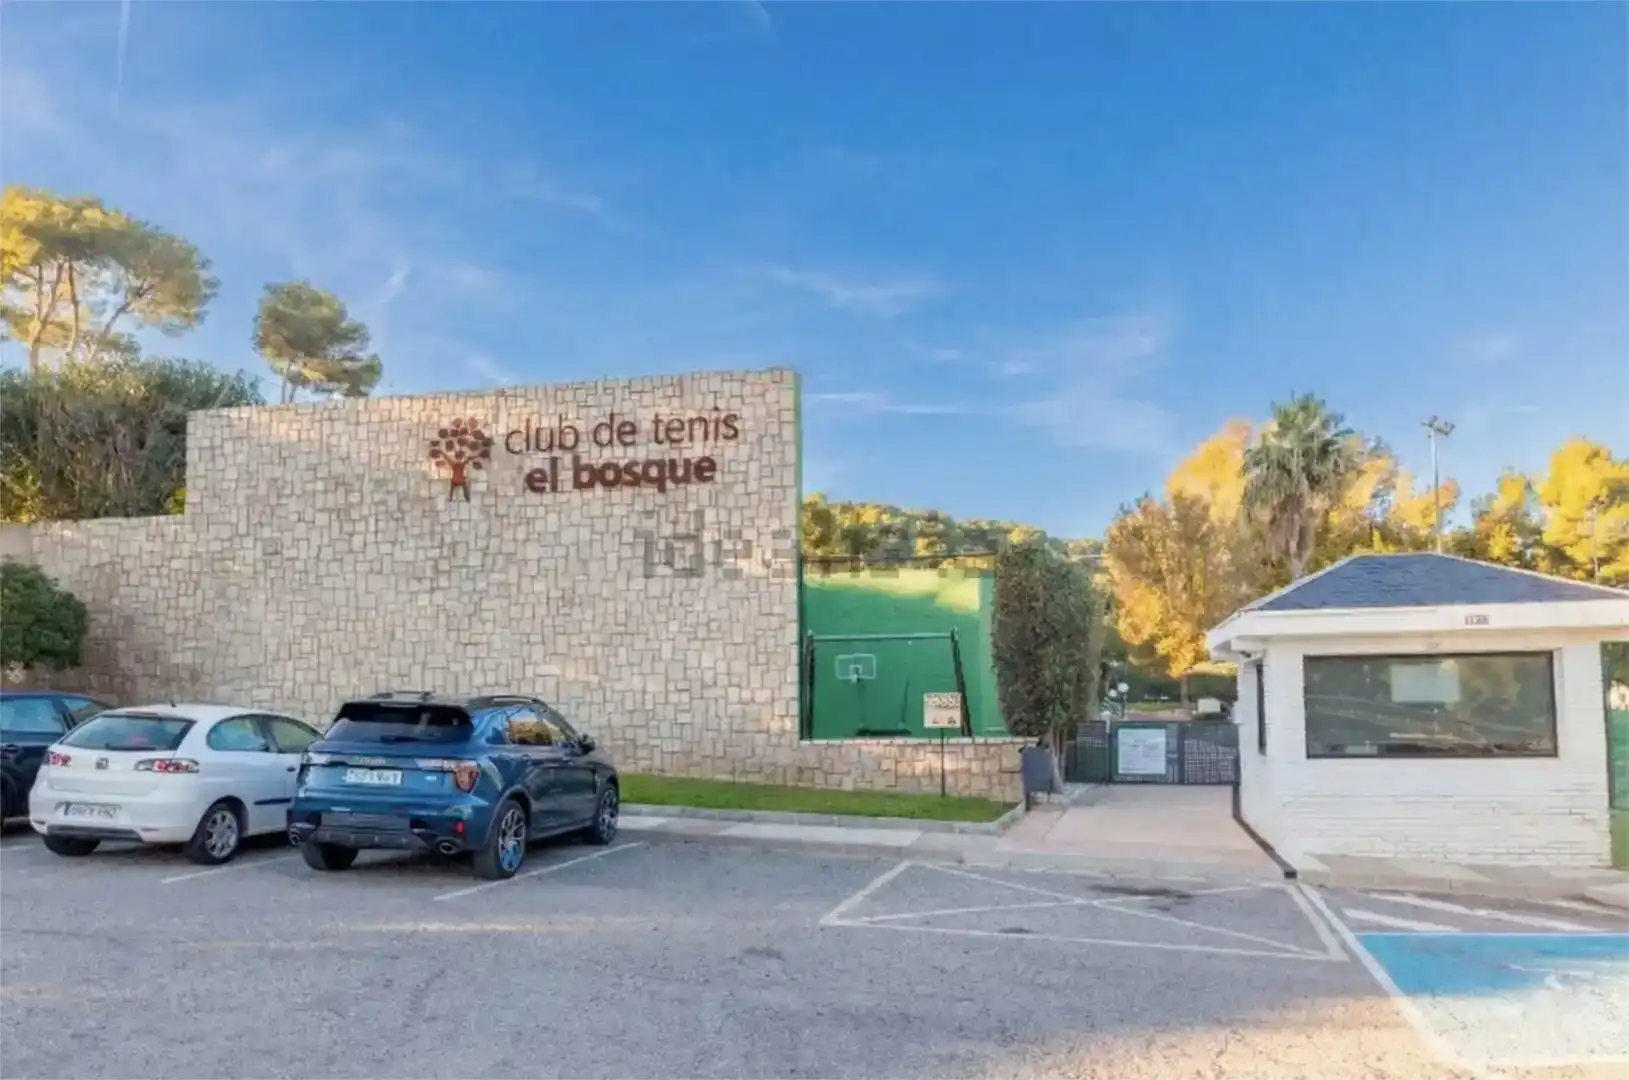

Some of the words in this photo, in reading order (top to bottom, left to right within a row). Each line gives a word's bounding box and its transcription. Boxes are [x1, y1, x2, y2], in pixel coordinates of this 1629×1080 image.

[505, 413, 580, 454] club
[592, 411, 638, 448] de
[653, 406, 740, 446] tenis
[525, 456, 559, 494] el
[572, 454, 717, 493] bosque
